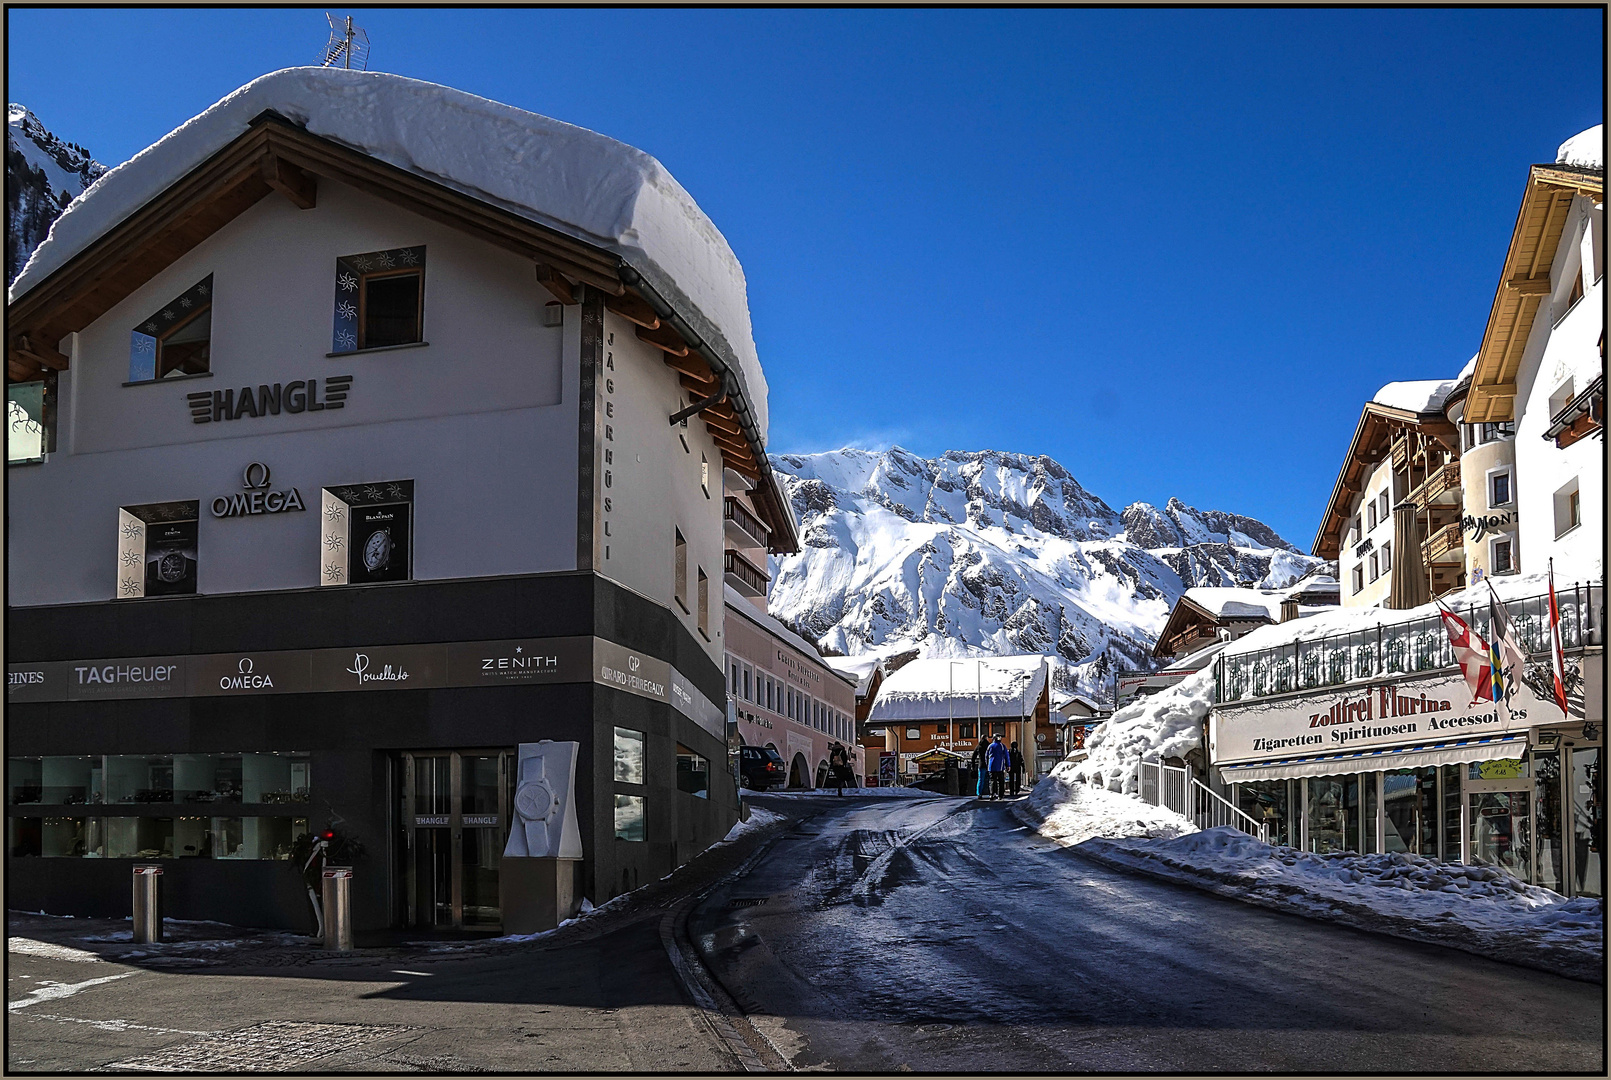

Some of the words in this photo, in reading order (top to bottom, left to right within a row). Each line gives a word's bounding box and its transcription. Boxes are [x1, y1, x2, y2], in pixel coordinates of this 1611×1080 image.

[212, 378, 325, 422] HANGL
[211, 486, 306, 518] OMEGA
[482, 656, 557, 669] ZENITH
[628, 655, 640, 672] GP
[219, 674, 274, 690] OMEGA
[1308, 686, 1373, 729] Zollfrei
[1379, 686, 1452, 719] Flurina
[1253, 733, 1323, 752] Zigaretten
[1331, 721, 1417, 744] Spirituosen
[1427, 708, 1528, 731] Accessoies
[420, 816, 445, 825] HANGL
